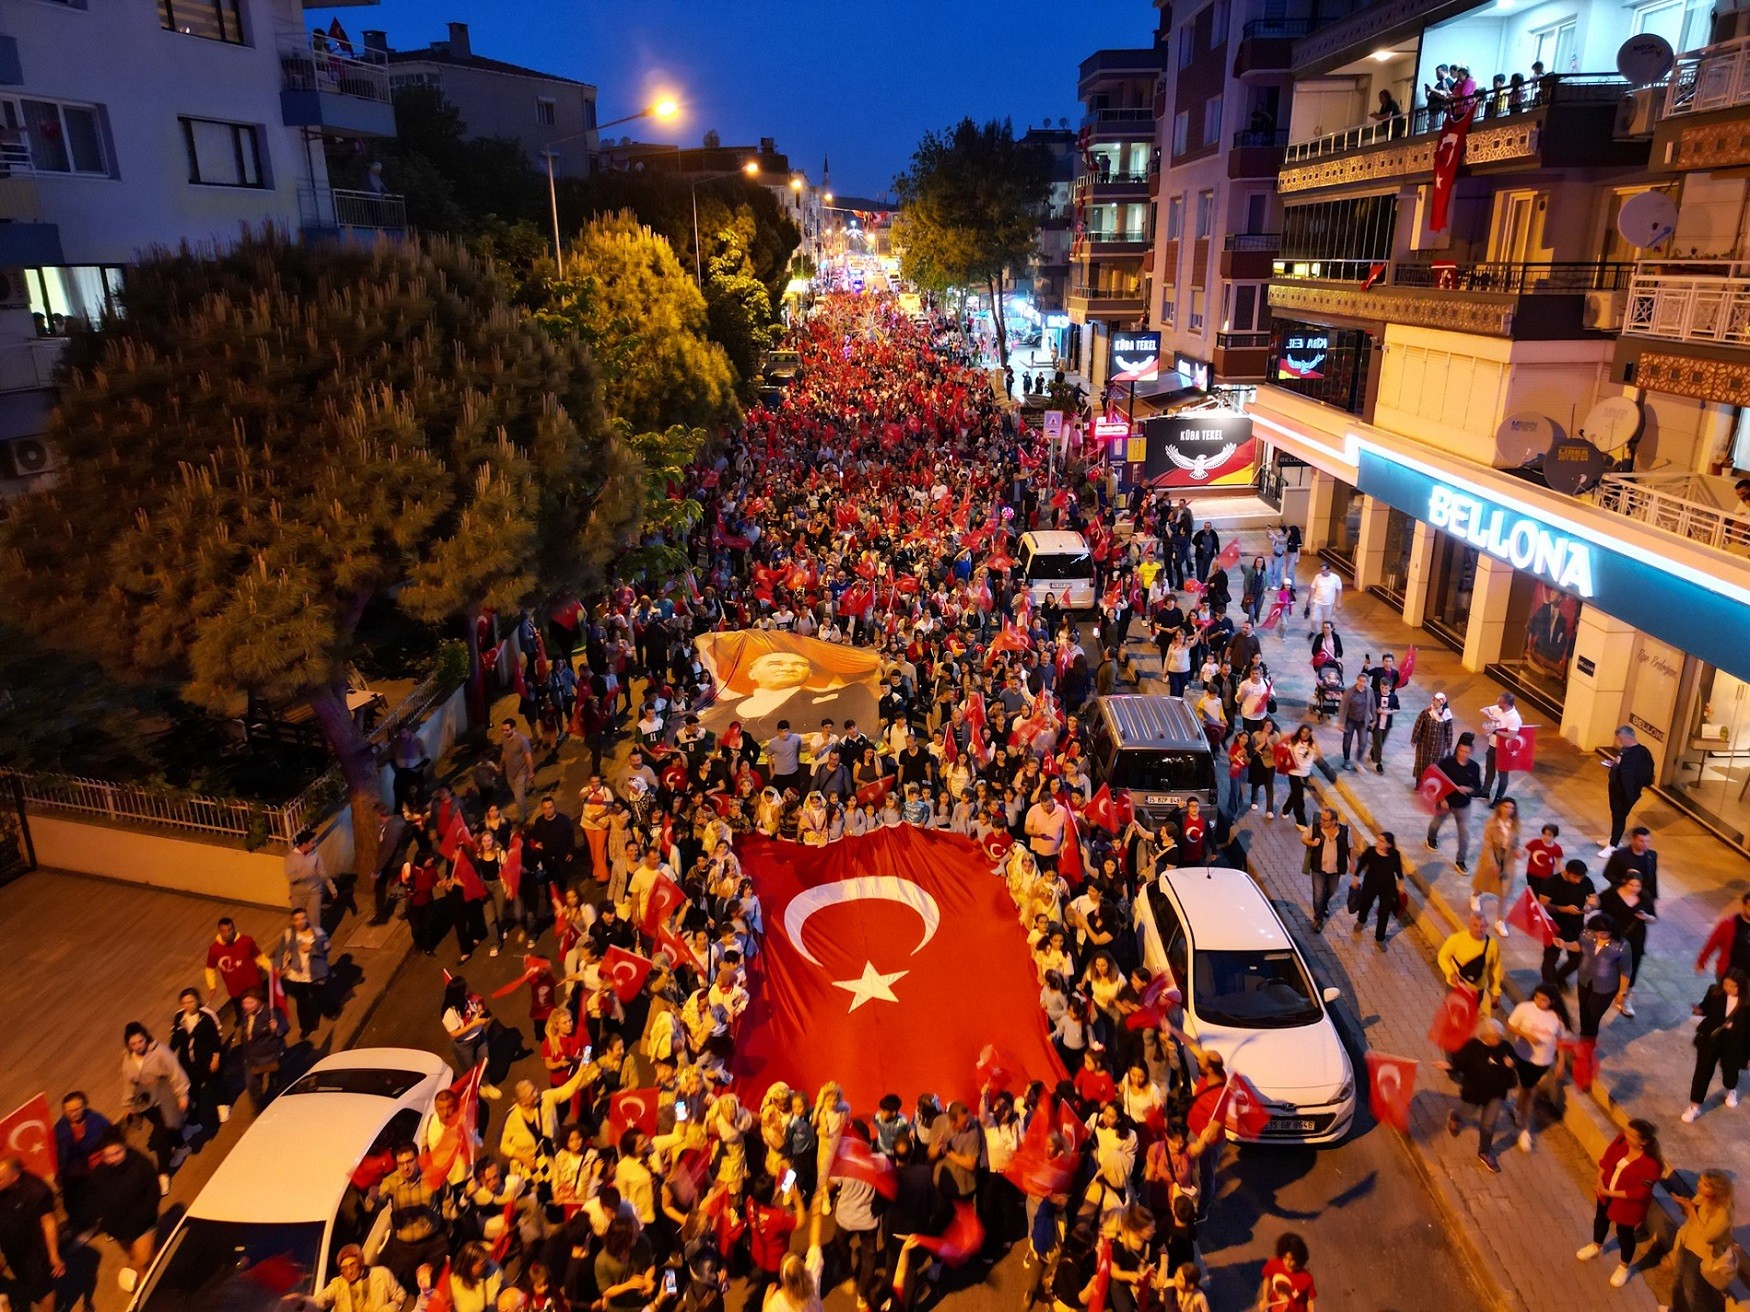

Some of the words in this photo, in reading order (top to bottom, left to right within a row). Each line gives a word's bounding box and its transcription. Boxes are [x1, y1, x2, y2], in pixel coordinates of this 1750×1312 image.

[1136, 339, 1157, 351] TEKEL
[1201, 429, 1223, 441] TEKEL
[1428, 485, 1594, 598] BELLONA
